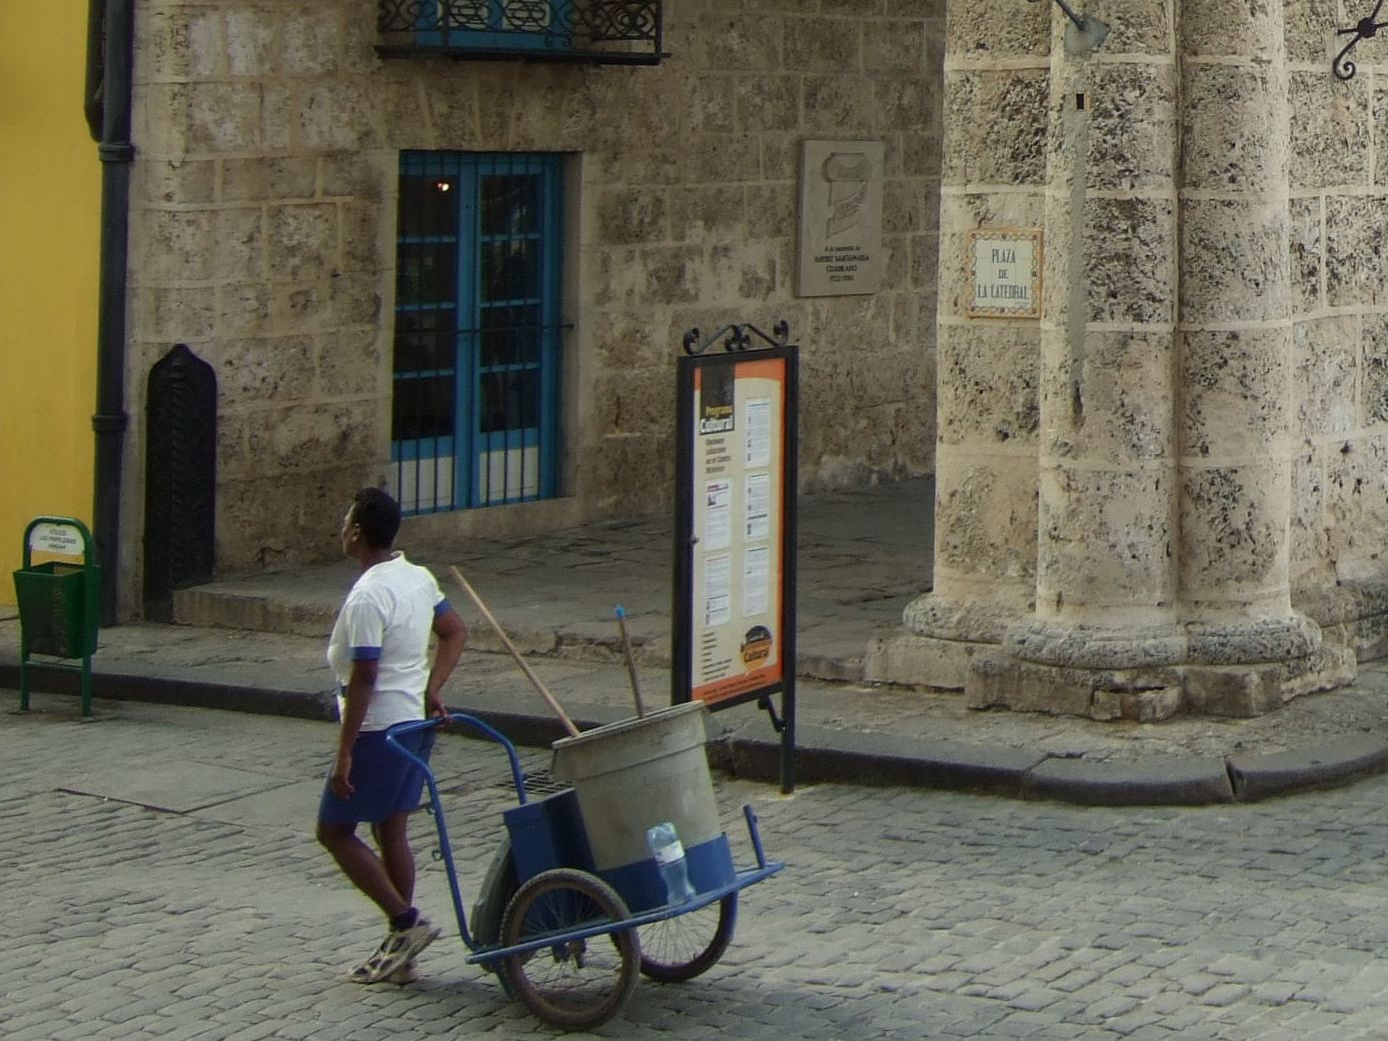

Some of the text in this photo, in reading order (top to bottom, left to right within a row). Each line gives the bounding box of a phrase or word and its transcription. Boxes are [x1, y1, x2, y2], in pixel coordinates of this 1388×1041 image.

[991, 248, 1016, 264] PLAZA
[998, 269, 1008, 279] DE
[977, 283, 1029, 300] LA CATEDRAL
